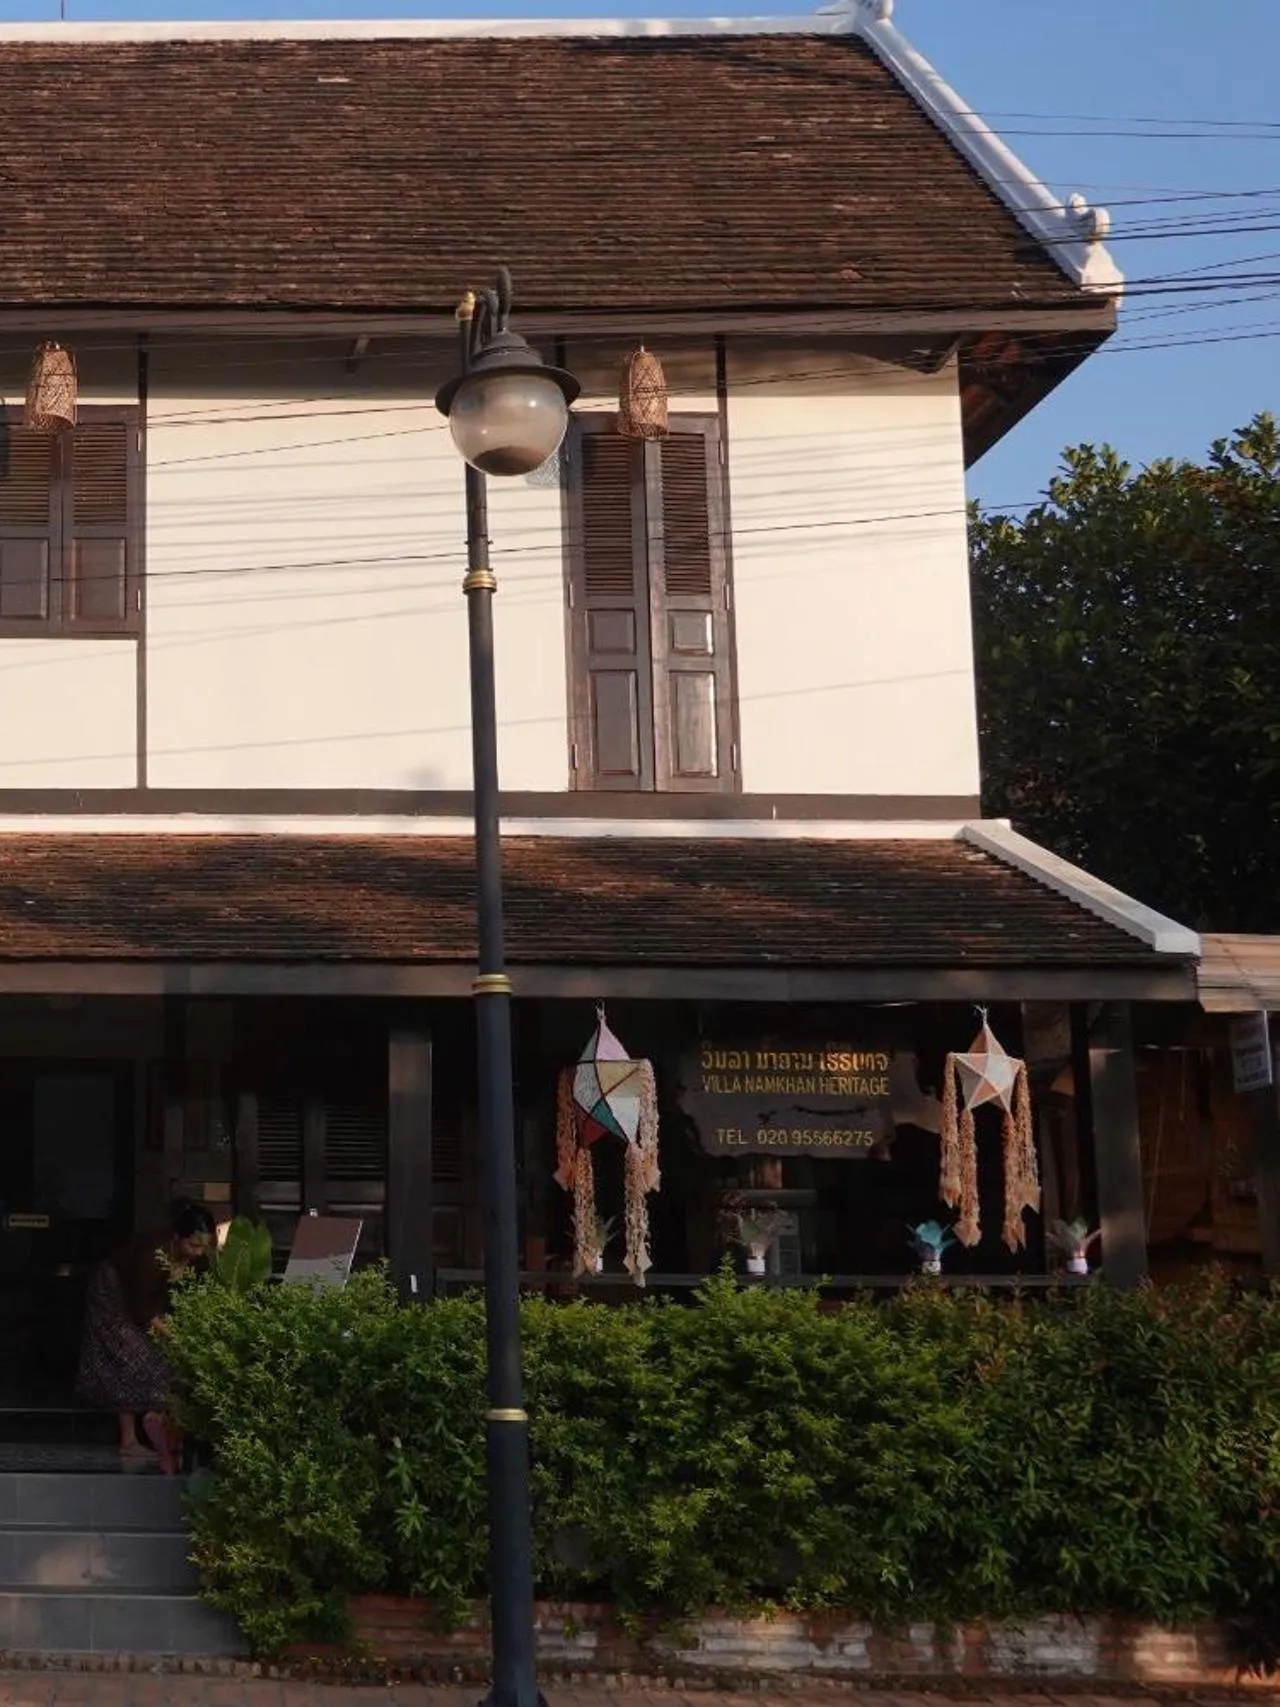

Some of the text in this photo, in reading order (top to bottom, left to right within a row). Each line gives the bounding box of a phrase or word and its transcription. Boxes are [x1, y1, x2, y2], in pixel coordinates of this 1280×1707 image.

[701, 1076, 890, 1096] VILLA NAMKHAN HERITAGE
[716, 1129, 748, 1145] TEL
[756, 1129, 788, 1146] 020
